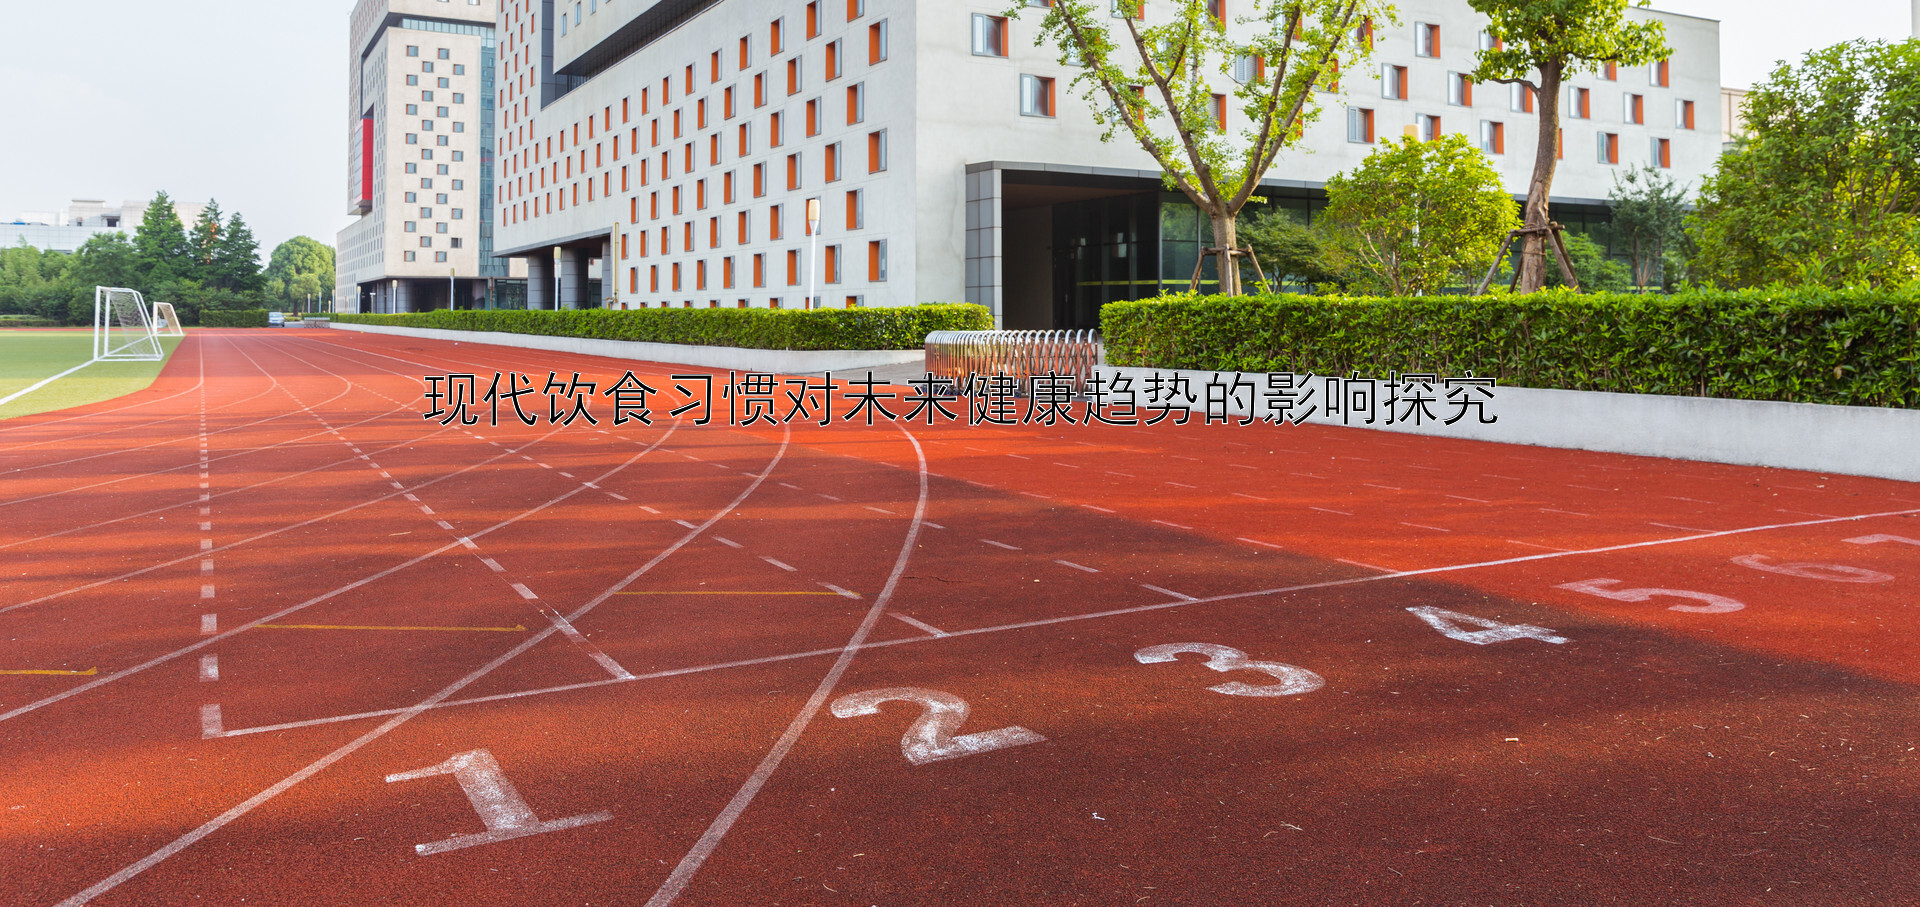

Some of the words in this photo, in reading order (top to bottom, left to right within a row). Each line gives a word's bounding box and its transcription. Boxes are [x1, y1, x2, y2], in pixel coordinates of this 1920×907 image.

[1730, 554, 1894, 583] 6
[1554, 577, 1745, 614] 5
[1405, 605, 1569, 645] 4
[1133, 642, 1326, 697] 3
[831, 687, 1046, 765] 2
[385, 748, 613, 856] 1
